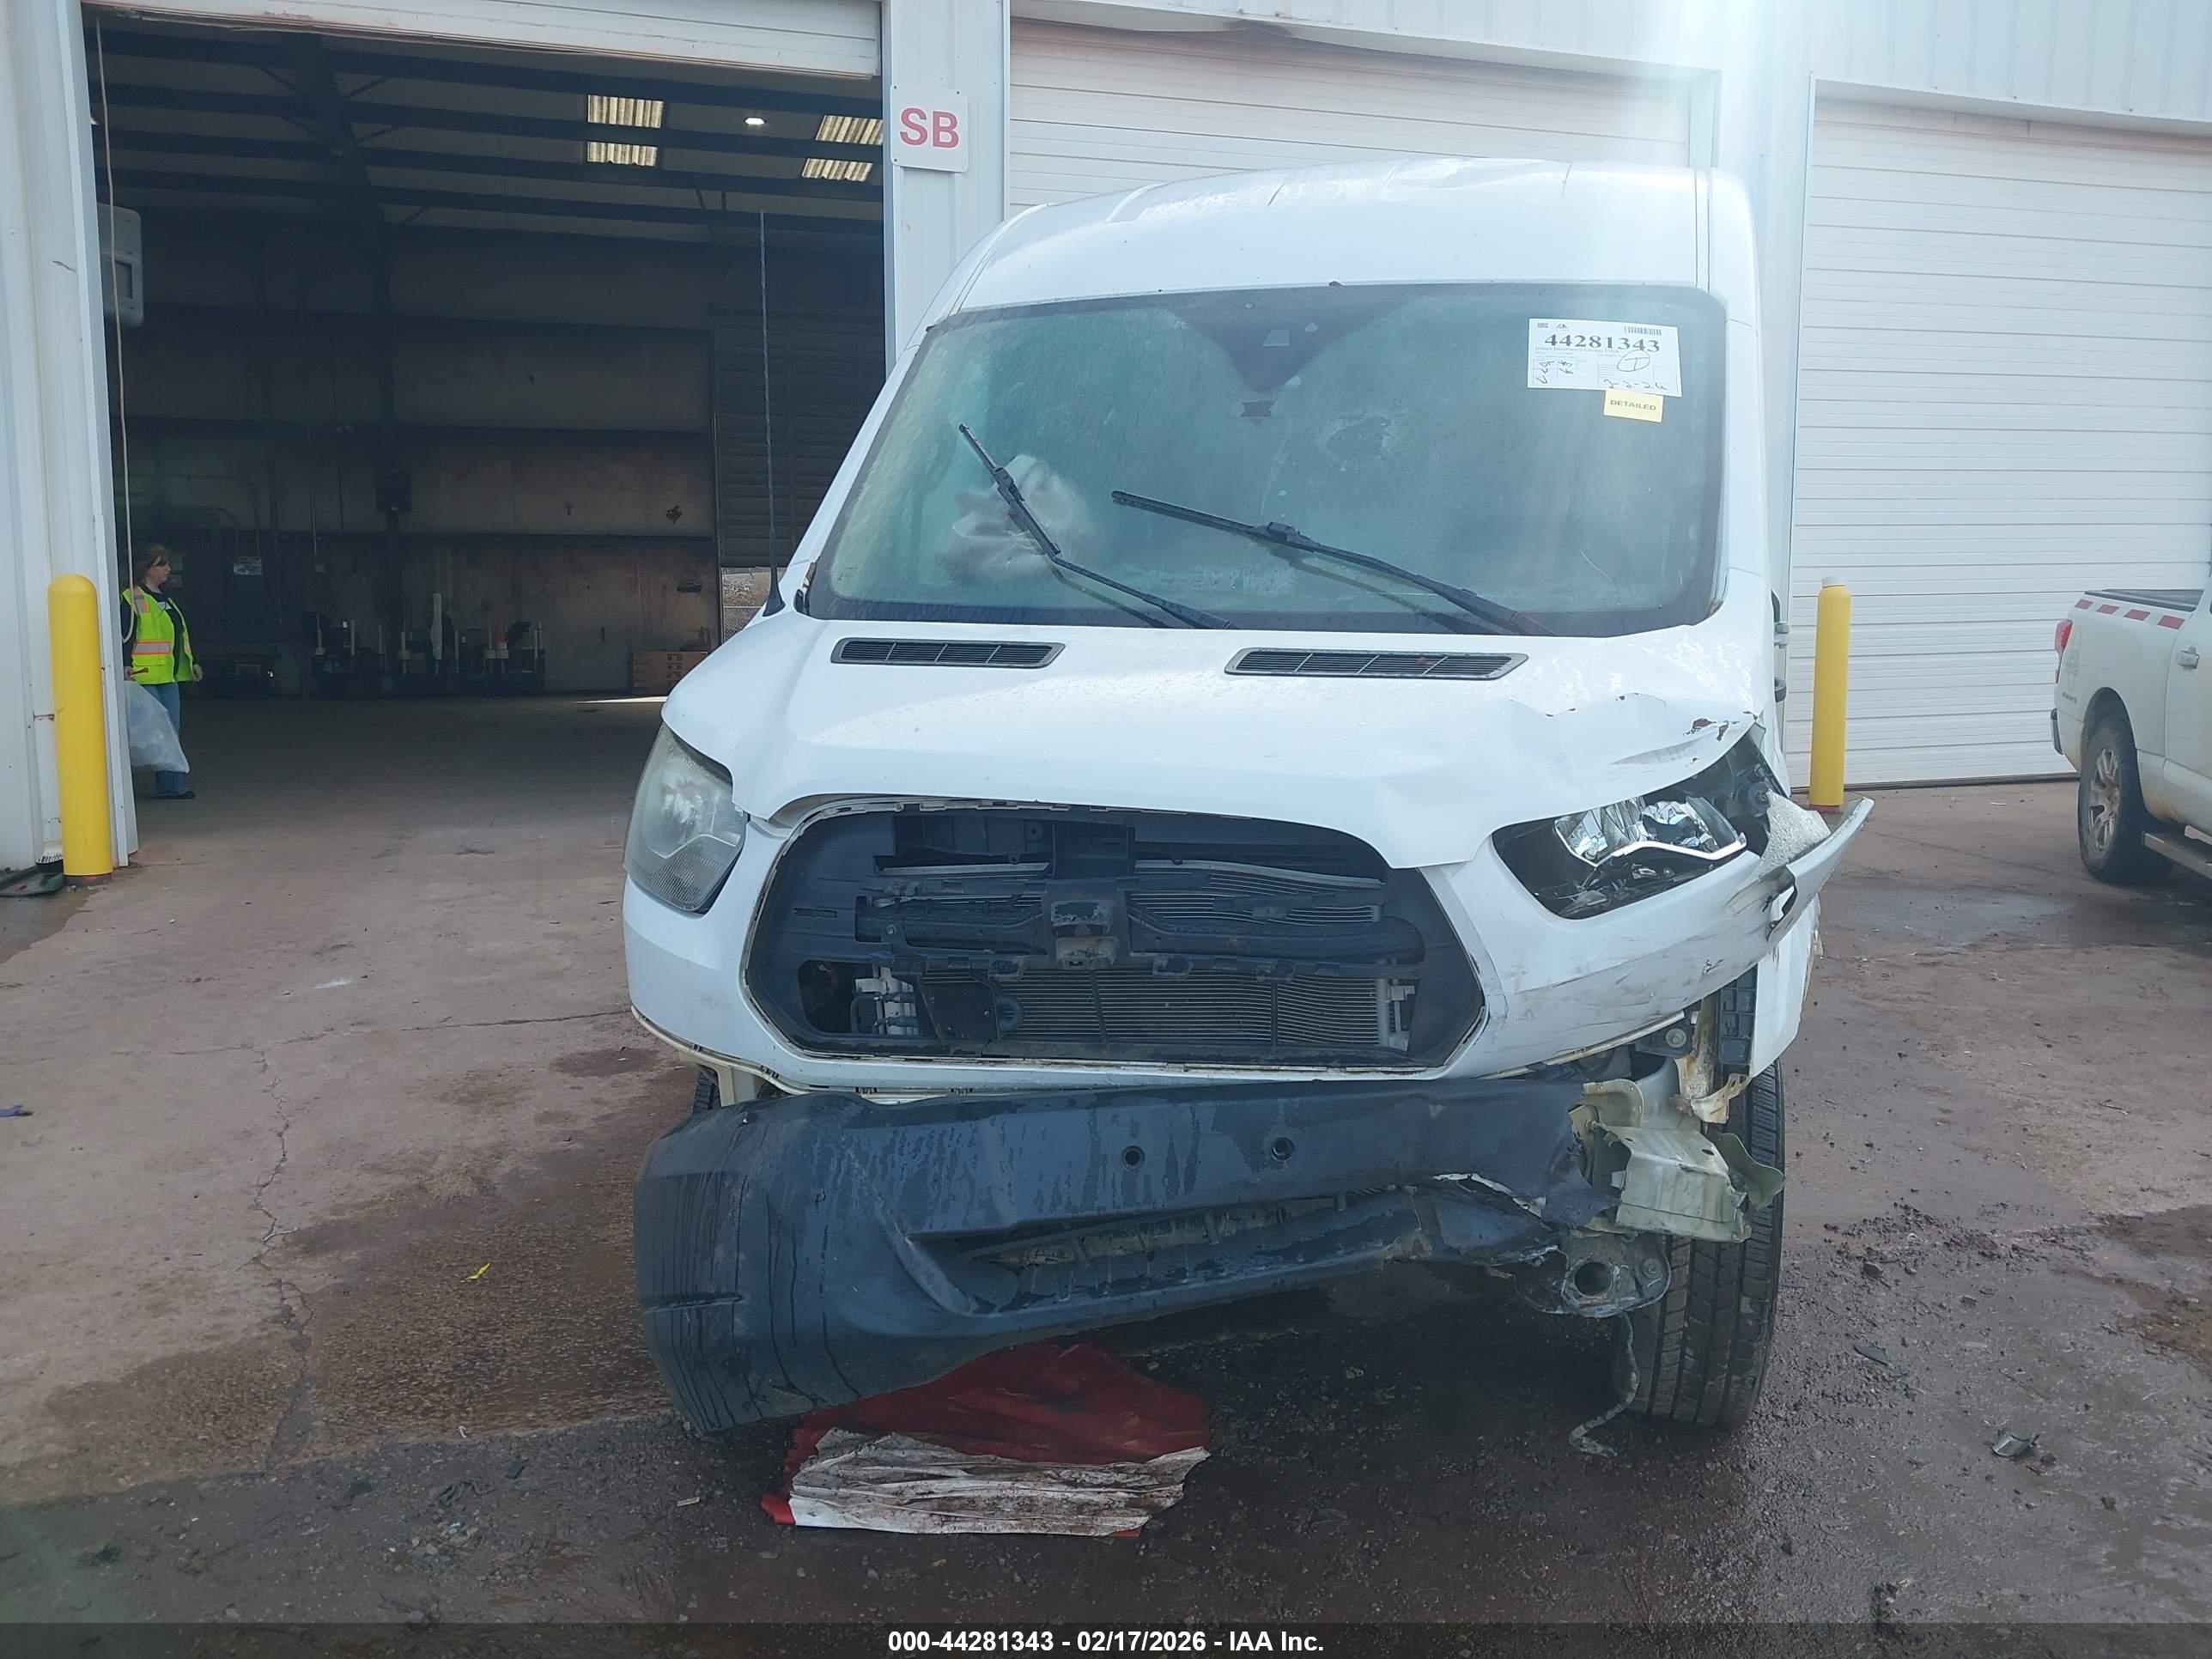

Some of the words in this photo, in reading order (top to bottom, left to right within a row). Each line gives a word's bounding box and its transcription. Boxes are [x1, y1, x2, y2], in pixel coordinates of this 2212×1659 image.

[900, 107, 959, 149] SB
[1544, 333, 1660, 353] 44281343
[1610, 399, 1656, 410] DETAILED
